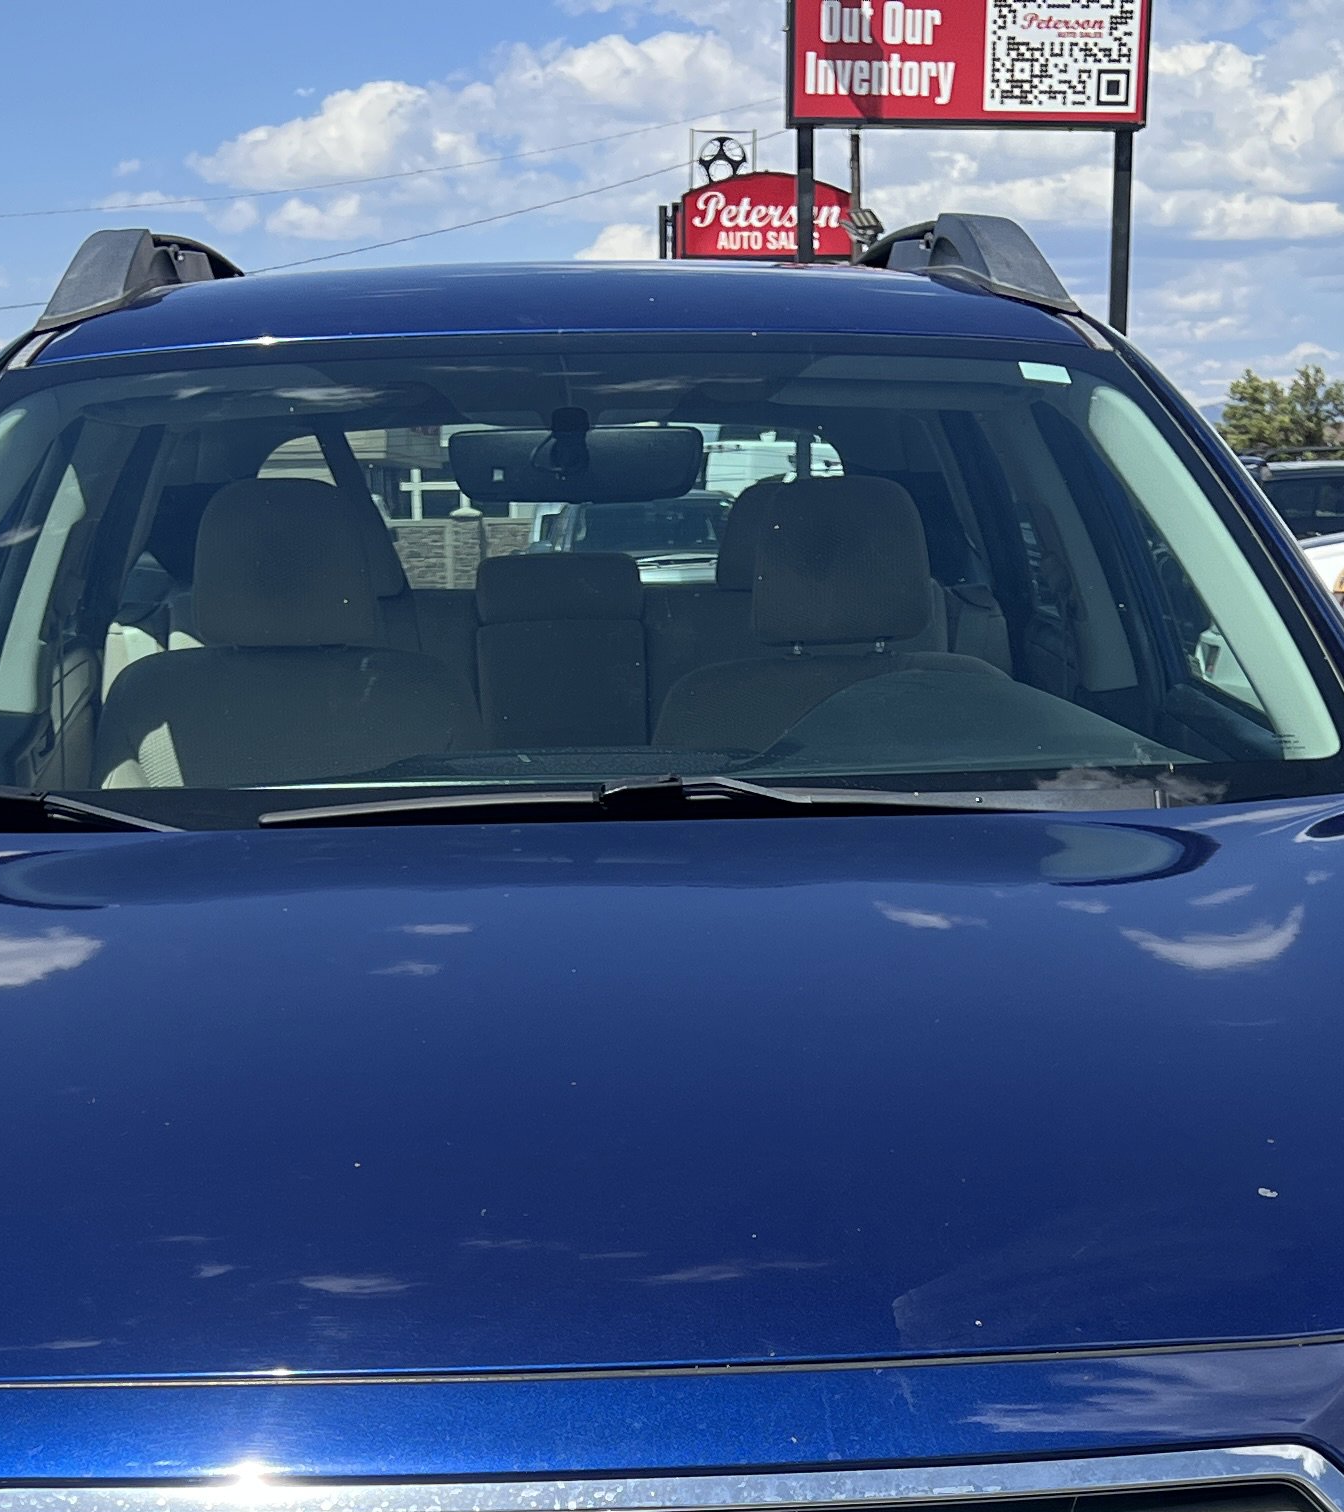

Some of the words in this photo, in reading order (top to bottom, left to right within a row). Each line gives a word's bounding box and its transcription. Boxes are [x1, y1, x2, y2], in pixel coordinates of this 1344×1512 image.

[820, 0, 874, 43] Out
[882, 1, 942, 45] Our
[805, 51, 956, 105] Inventory
[692, 191, 842, 229] Petersn
[717, 231, 763, 251] AUTO
[766, 231, 821, 251] SALS
